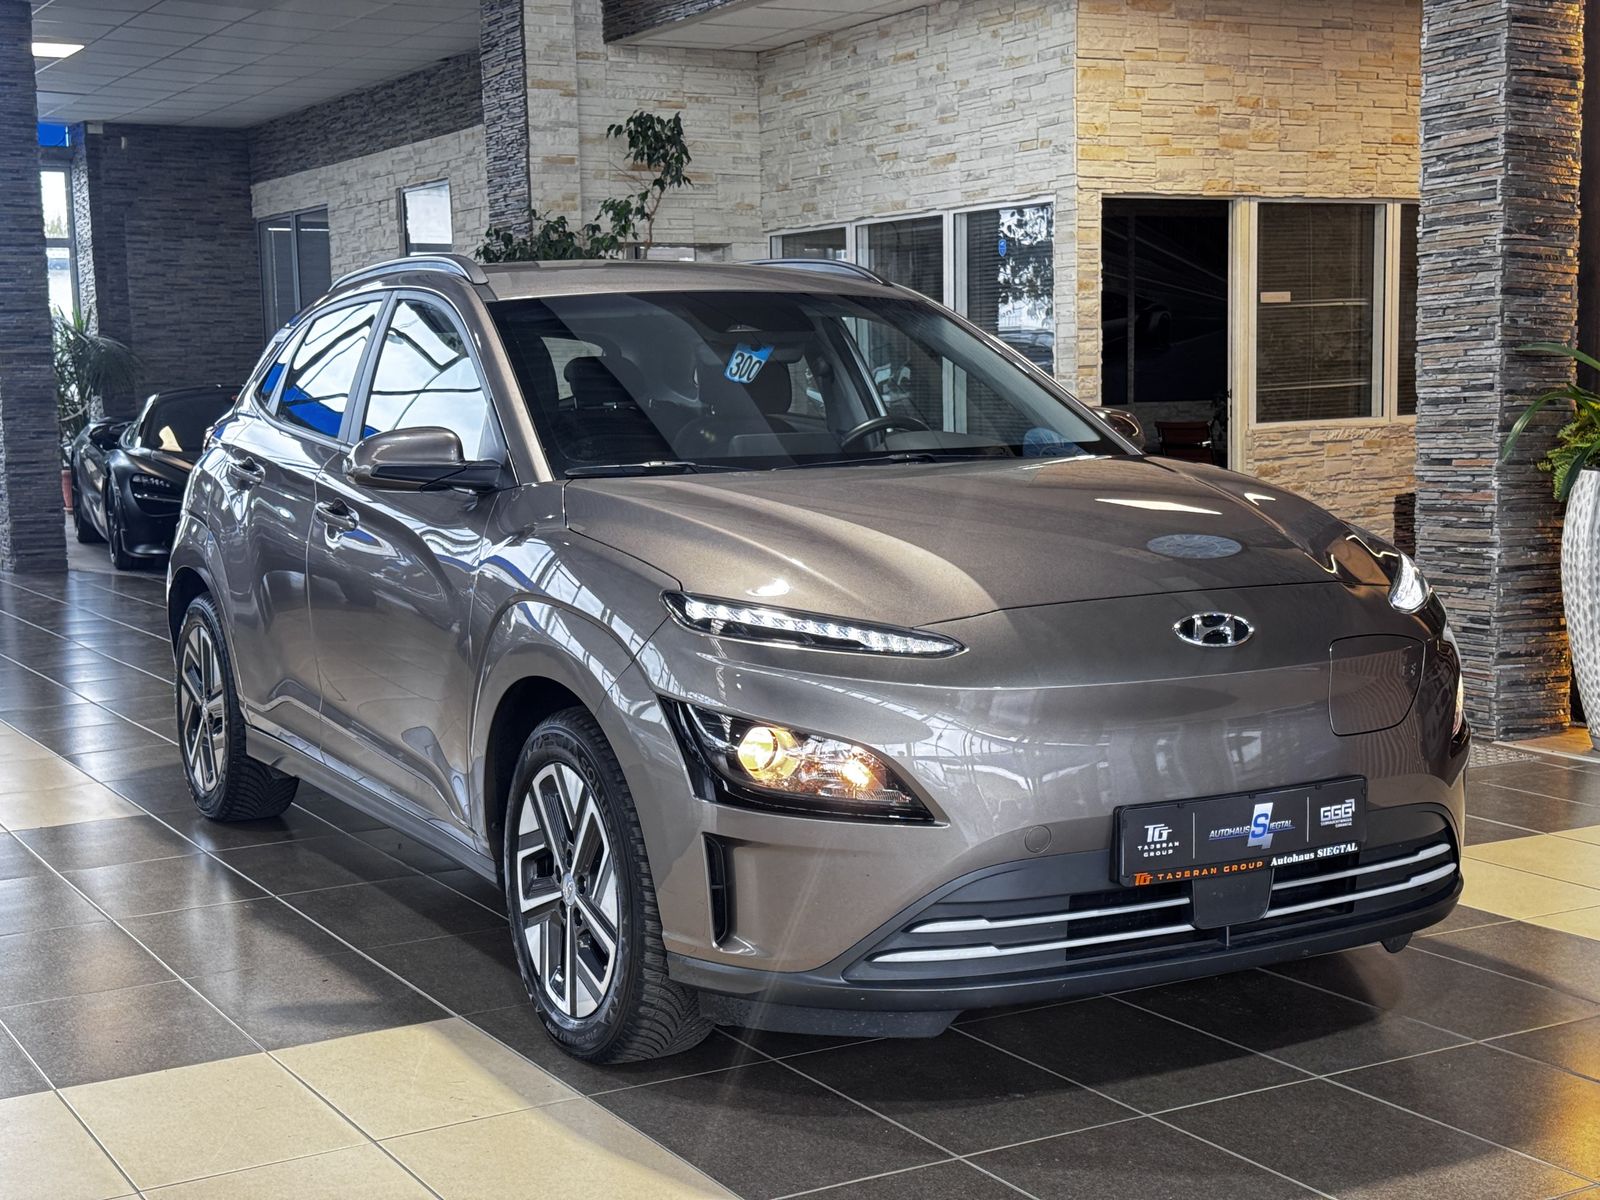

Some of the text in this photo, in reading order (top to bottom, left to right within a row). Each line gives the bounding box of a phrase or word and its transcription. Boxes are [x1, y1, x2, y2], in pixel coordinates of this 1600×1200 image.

[729, 352, 763, 382] 300
[1321, 802, 1353, 822] GGG
[1209, 825, 1250, 838] AUTOHAUS
[1143, 849, 1174, 858] GROUP
[1270, 842, 1359, 867] Autohaus SIEGTAL
[1223, 861, 1264, 873] GROUP
